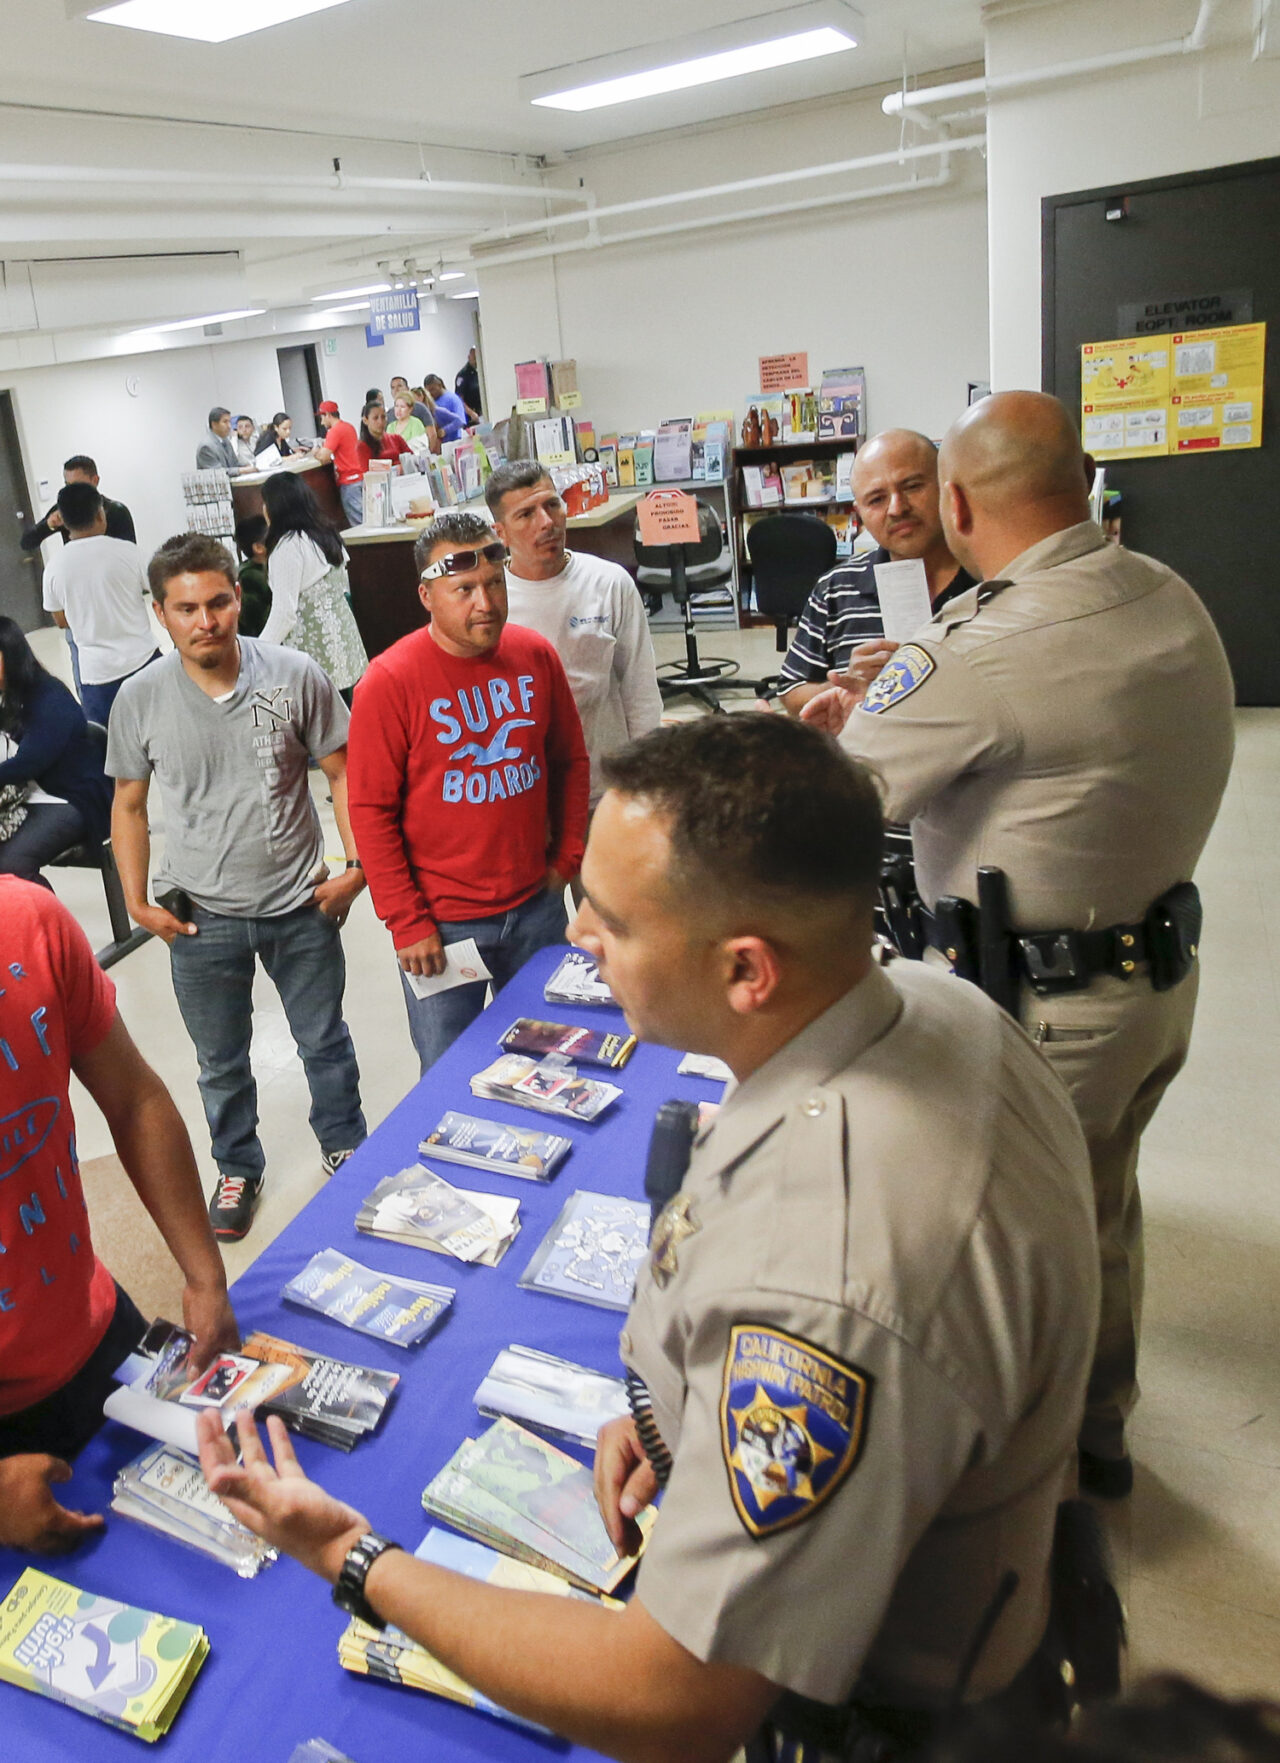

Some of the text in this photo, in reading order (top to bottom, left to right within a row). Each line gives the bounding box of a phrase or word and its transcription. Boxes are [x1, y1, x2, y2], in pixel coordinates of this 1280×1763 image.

[371, 293, 417, 313] VENTANILLA
[375, 312, 415, 331] DE SALUD
[1145, 296, 1221, 317] ELEVATOR
[1185, 310, 1232, 326] ROOM
[429, 675, 534, 744] SURF
[252, 731, 286, 748] ATHLE
[443, 755, 540, 804] BOARDS
[740, 1334, 847, 1399] CALIFORNIA
[733, 1359, 850, 1431] HIGHWAY PATROL
[14, 1612, 58, 1665] turn!
[32, 1614, 75, 1668] right
